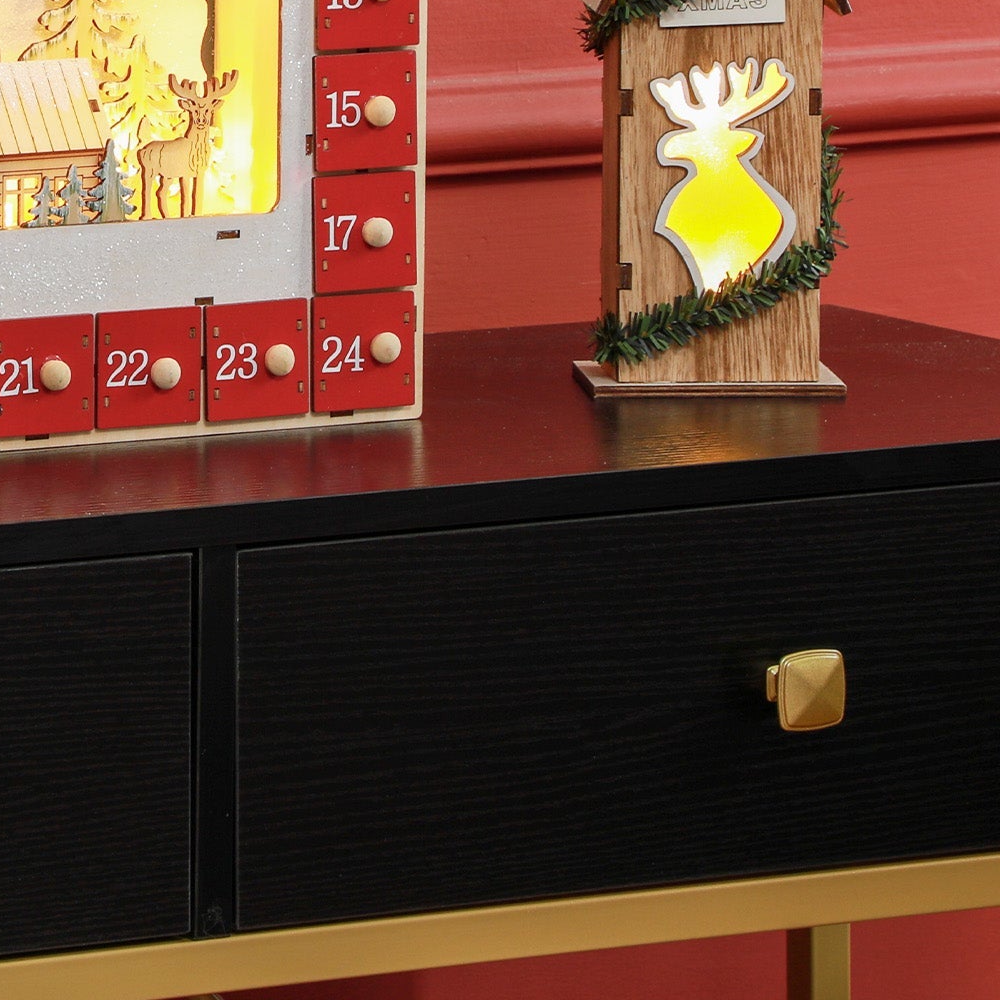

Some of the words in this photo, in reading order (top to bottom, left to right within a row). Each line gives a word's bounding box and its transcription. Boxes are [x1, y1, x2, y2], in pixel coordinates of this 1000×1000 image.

[326, 91, 360, 127] 15
[324, 215, 357, 251] 17
[107, 350, 148, 387] 22
[216, 343, 257, 380] 23
[322, 336, 364, 373] 24
[0, 357, 38, 396] 21
